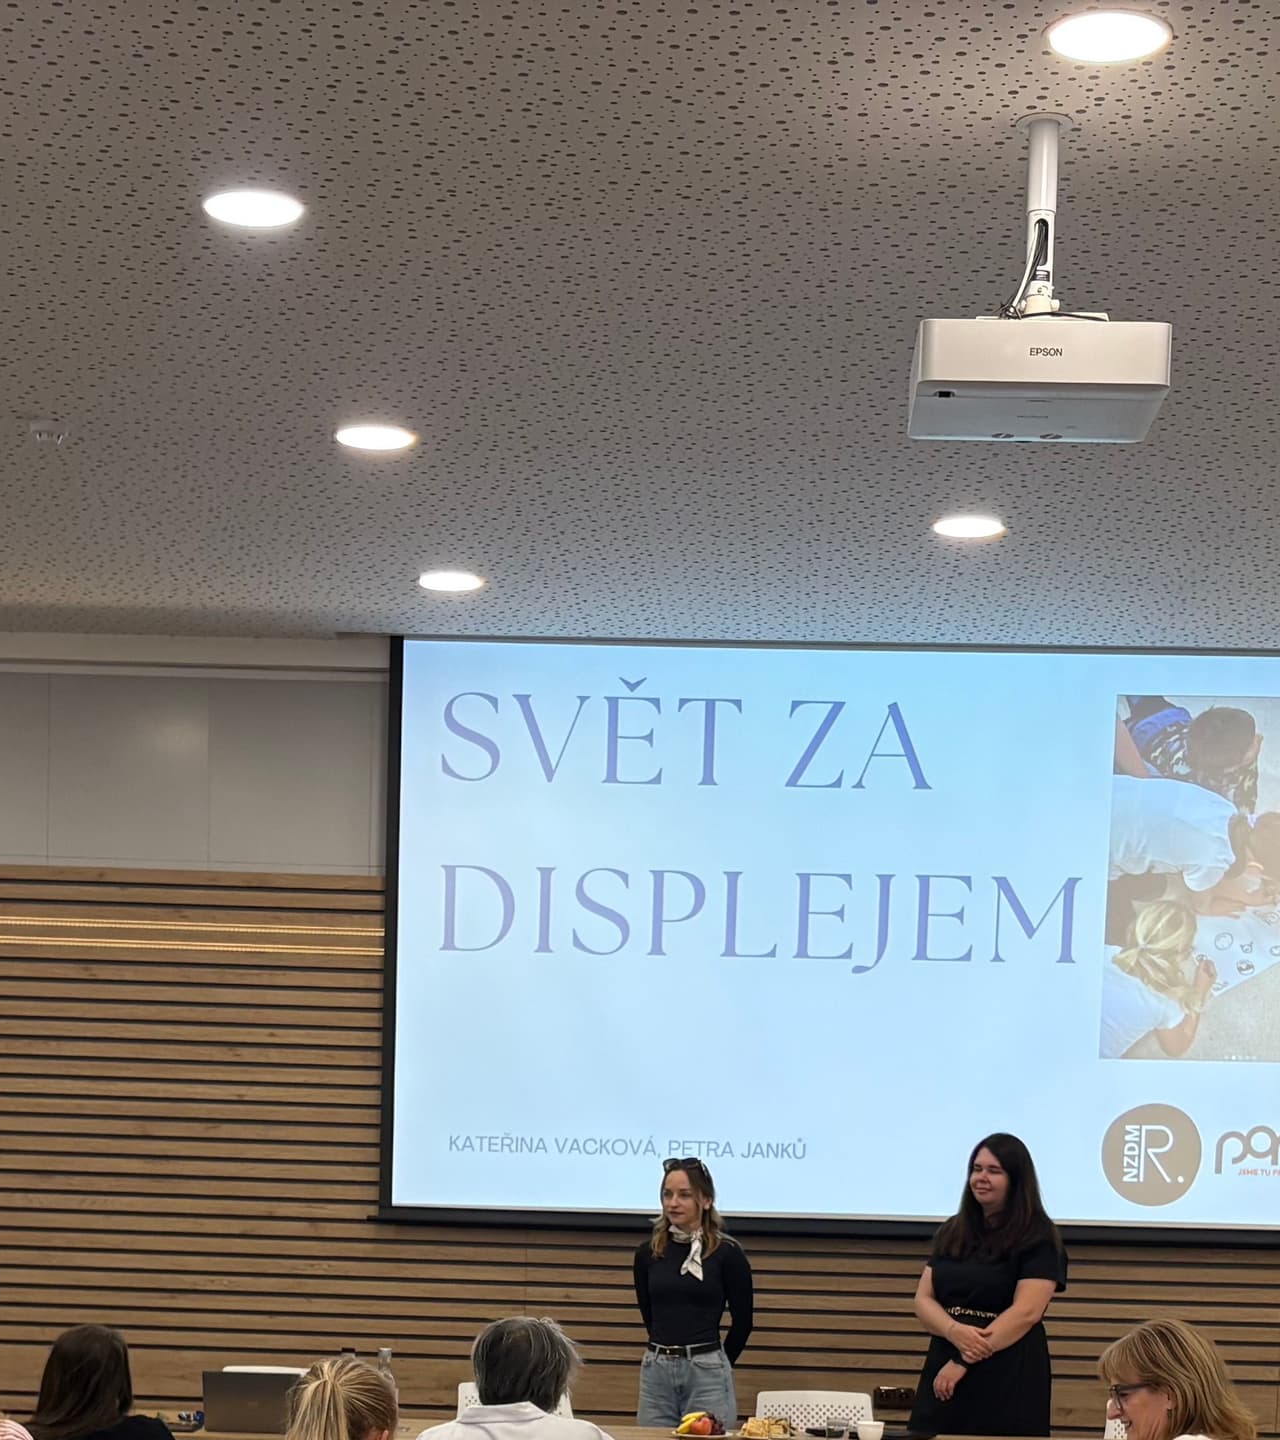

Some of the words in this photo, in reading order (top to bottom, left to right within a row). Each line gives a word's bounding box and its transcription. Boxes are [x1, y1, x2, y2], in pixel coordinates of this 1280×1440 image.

[1029, 347, 1063, 357] EPSON
[439, 676, 743, 788] SVĚT
[785, 699, 933, 791] ZA
[438, 863, 1083, 975] DISPLEJEM
[448, 1132, 548, 1154] KATEŘINA
[554, 1135, 662, 1160] VACKOVÁ,
[668, 1140, 735, 1159] PETRA
[741, 1138, 807, 1160] JANKŮ
[1122, 1124, 1140, 1182] NZDM
